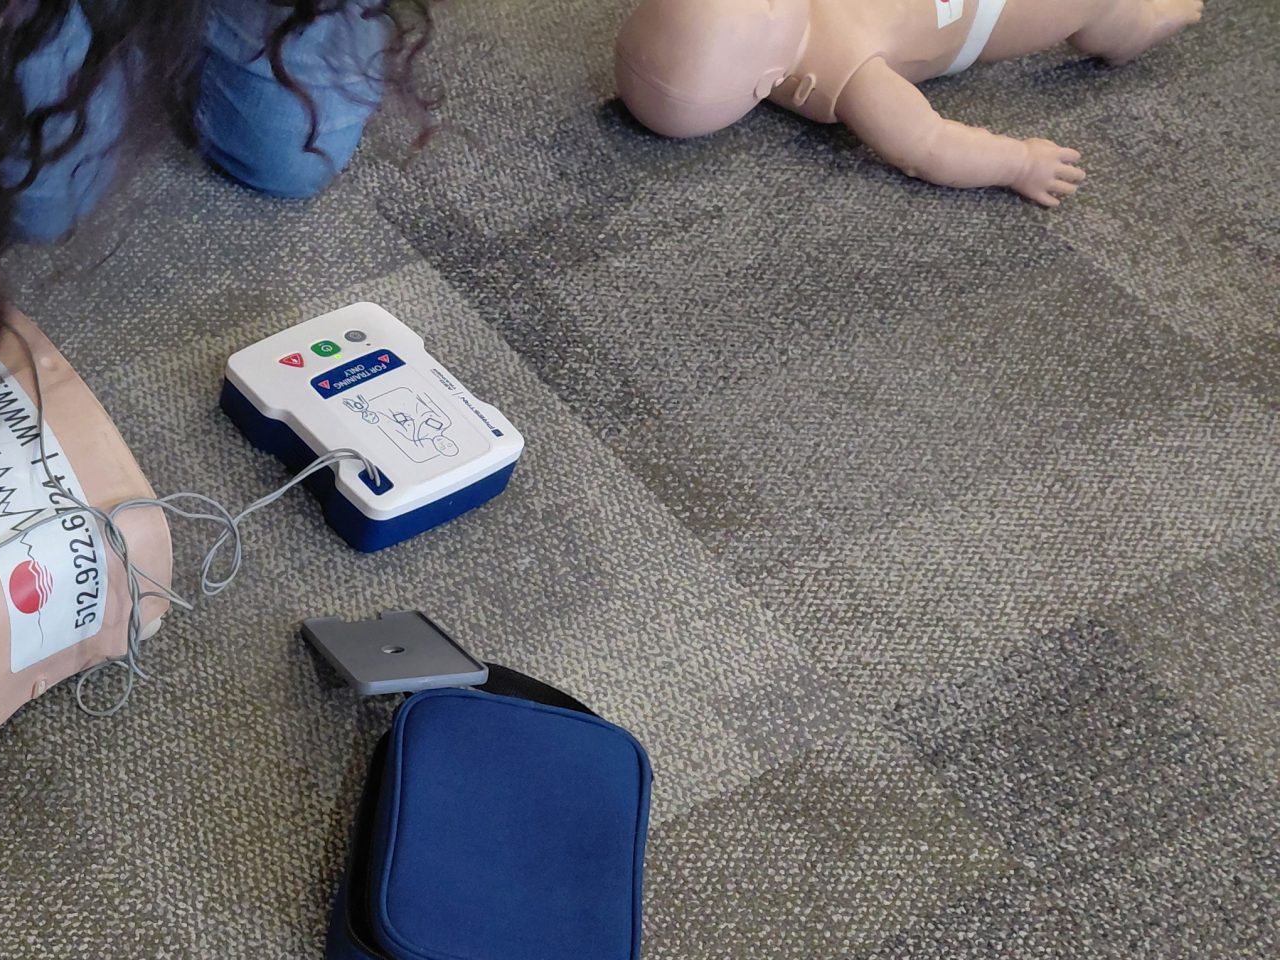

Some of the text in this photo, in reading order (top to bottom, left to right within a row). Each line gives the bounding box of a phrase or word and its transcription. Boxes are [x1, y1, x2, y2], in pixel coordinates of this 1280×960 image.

[333, 363, 387, 390] FOR TRAINING
[344, 364, 365, 377] ONLY
